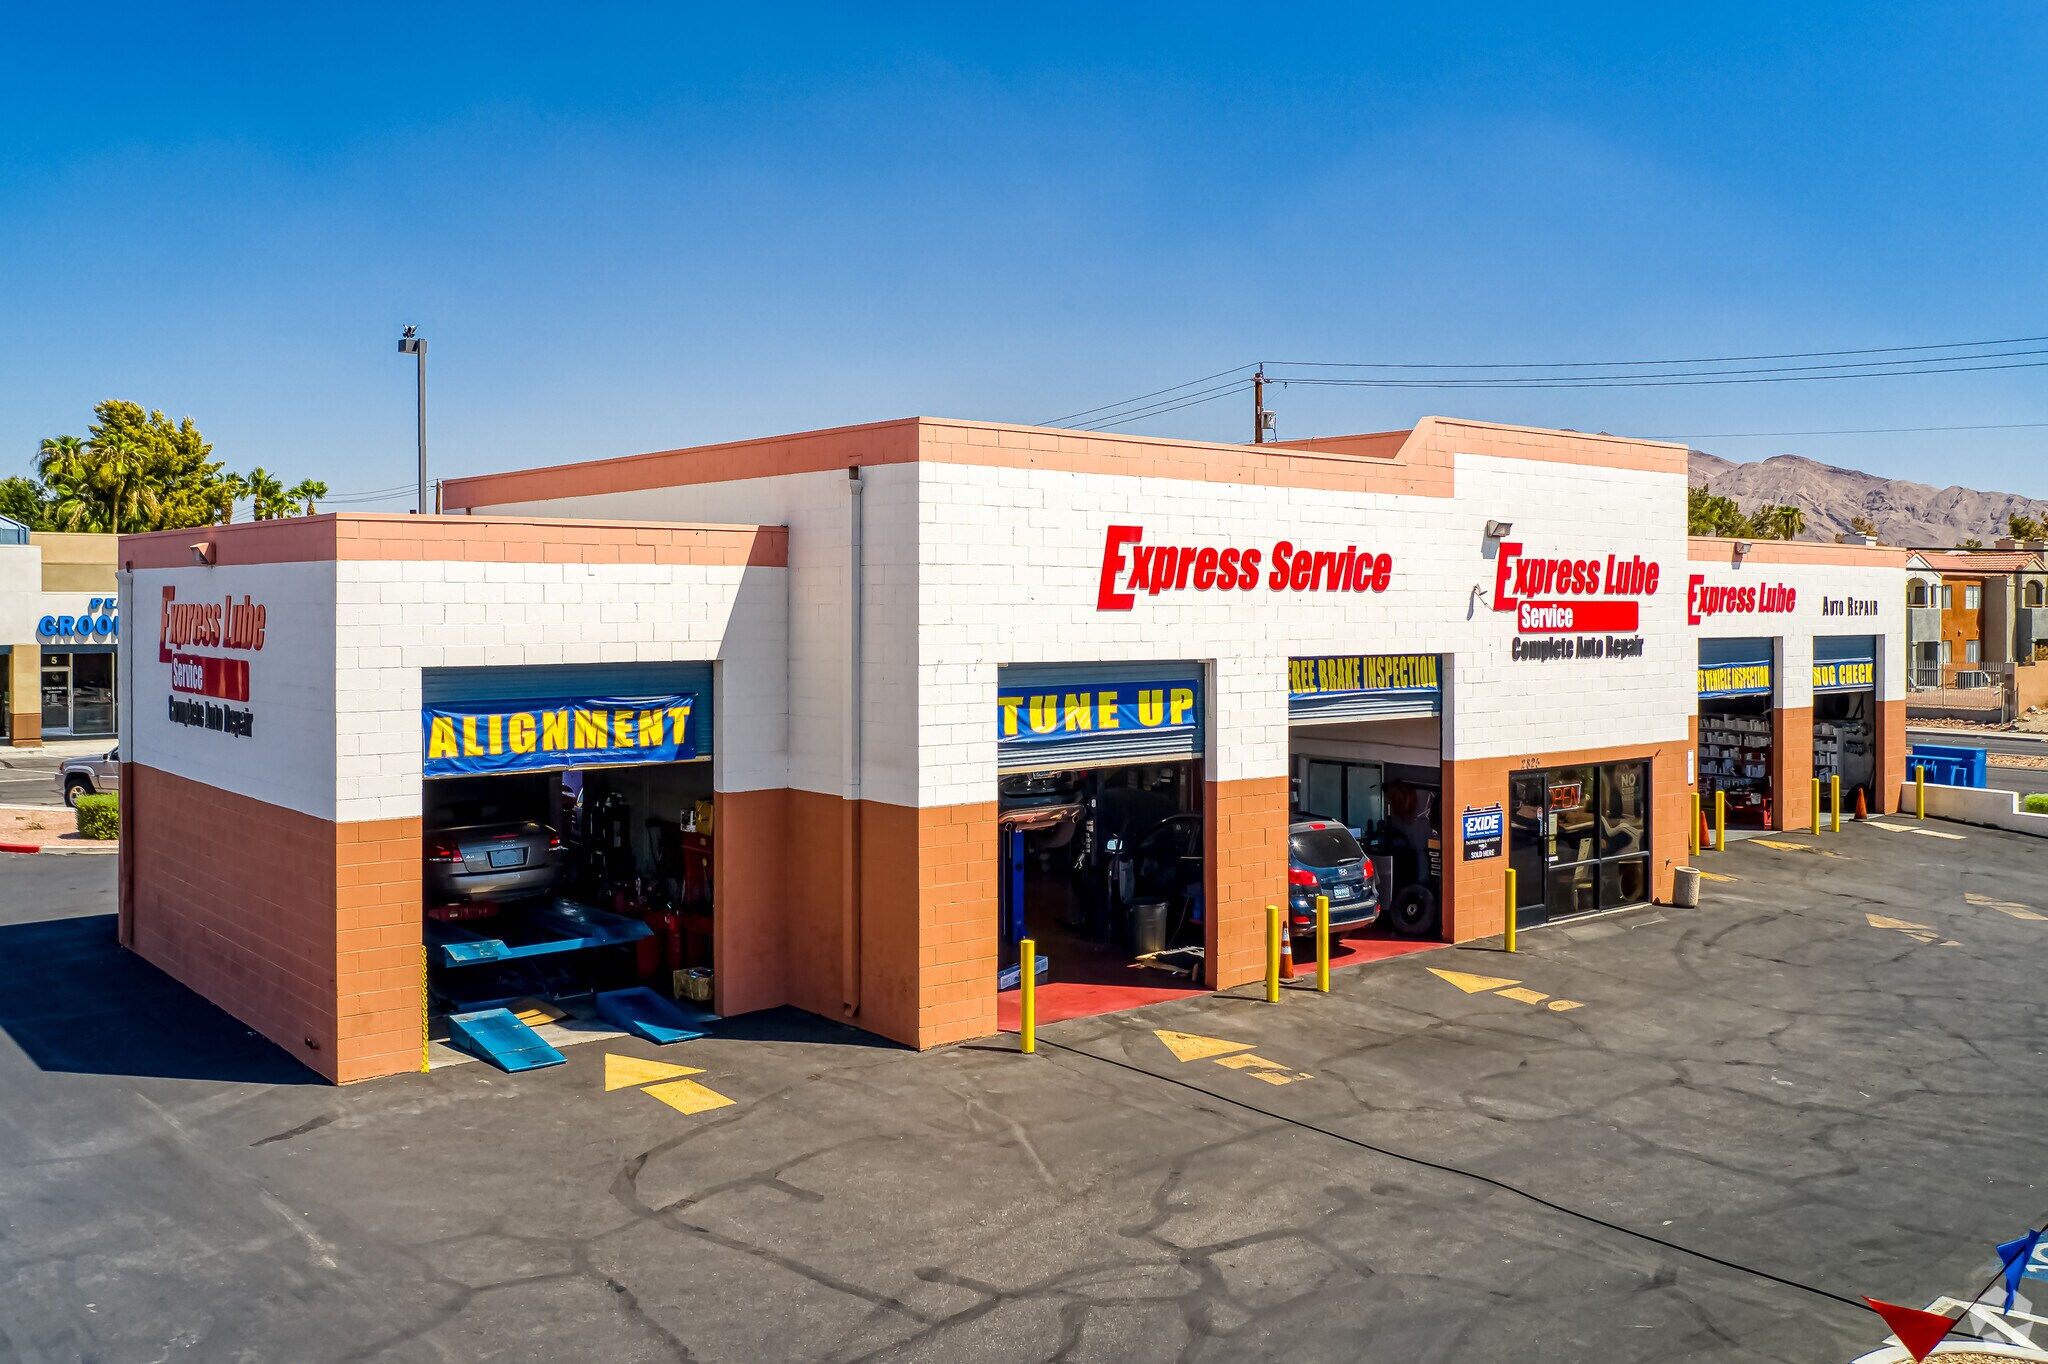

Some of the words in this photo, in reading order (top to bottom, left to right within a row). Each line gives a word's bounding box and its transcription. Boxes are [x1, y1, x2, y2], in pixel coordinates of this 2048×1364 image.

[1096, 525, 1262, 612] Express
[1268, 540, 1393, 594] Service
[1493, 542, 1601, 612] Express
[1603, 554, 1660, 596] Lube
[1688, 574, 1757, 626] Express
[1758, 582, 1797, 614] Lube
[159, 585, 222, 663] Express
[223, 595, 266, 652] Lube
[1521, 603, 1574, 629] Service
[51, 656, 58, 665] 5
[1511, 636, 1574, 663] Complete
[1575, 636, 1604, 660] Auto
[1605, 635, 1644, 660] Repair
[173, 657, 203, 691] Service
[1317, 658, 1361, 692] BRAKE
[1363, 655, 1438, 689] INSPECTION
[1705, 667, 1732, 692] VEHICLE
[1731, 665, 1770, 690] INSPECTION
[1838, 663, 1873, 685] CHECK
[998, 691, 1121, 737] TUNE
[1137, 687, 1195, 728] UP
[428, 706, 691, 758] ALIGNMENT
[1621, 773, 1636, 787] NO
[1465, 815, 1500, 832] EXIDE
[1471, 850, 1482, 859] SOLD
[1483, 849, 1495, 857] HERE
